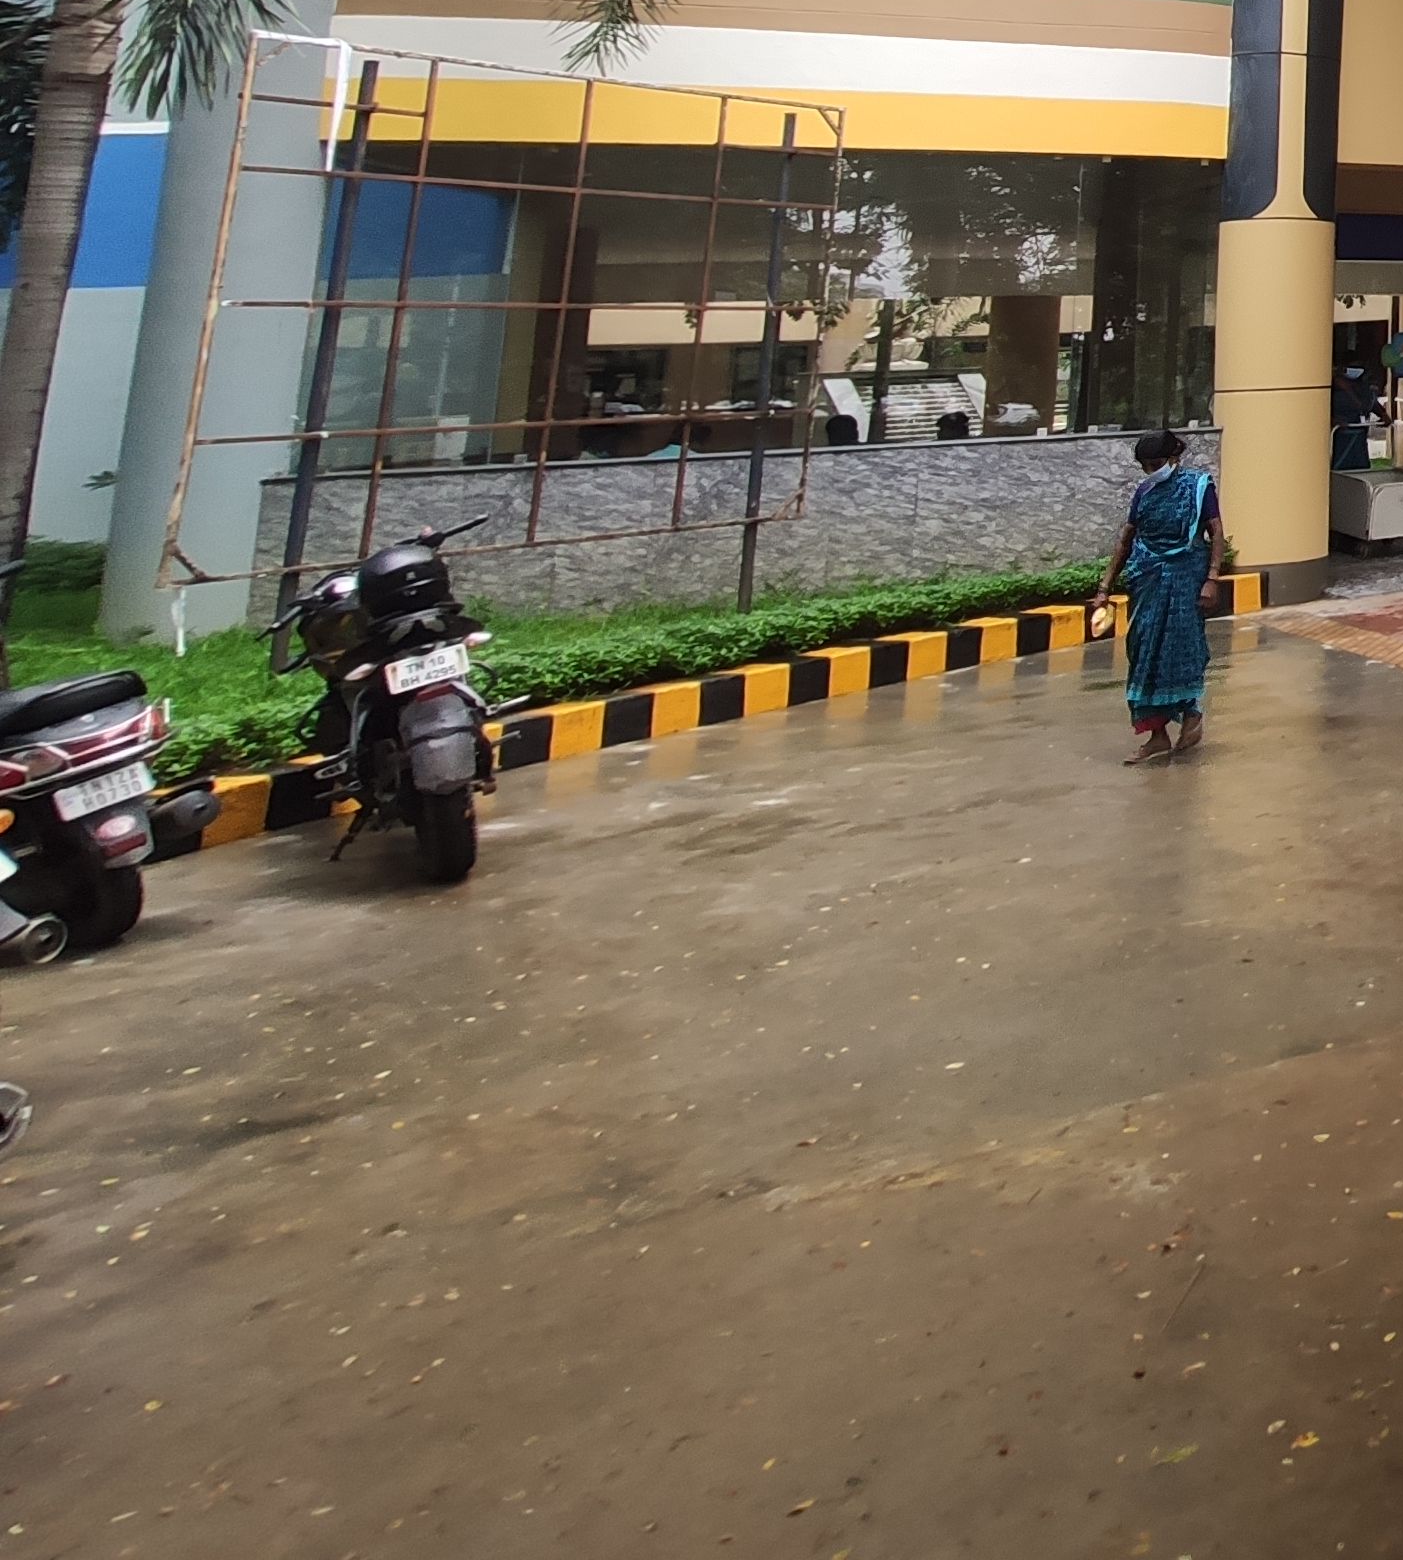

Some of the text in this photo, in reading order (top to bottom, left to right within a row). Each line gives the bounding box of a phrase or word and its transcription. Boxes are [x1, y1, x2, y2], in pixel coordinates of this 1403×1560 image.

[405, 655, 445, 673] TN 10
[425, 664, 457, 680] 4295
